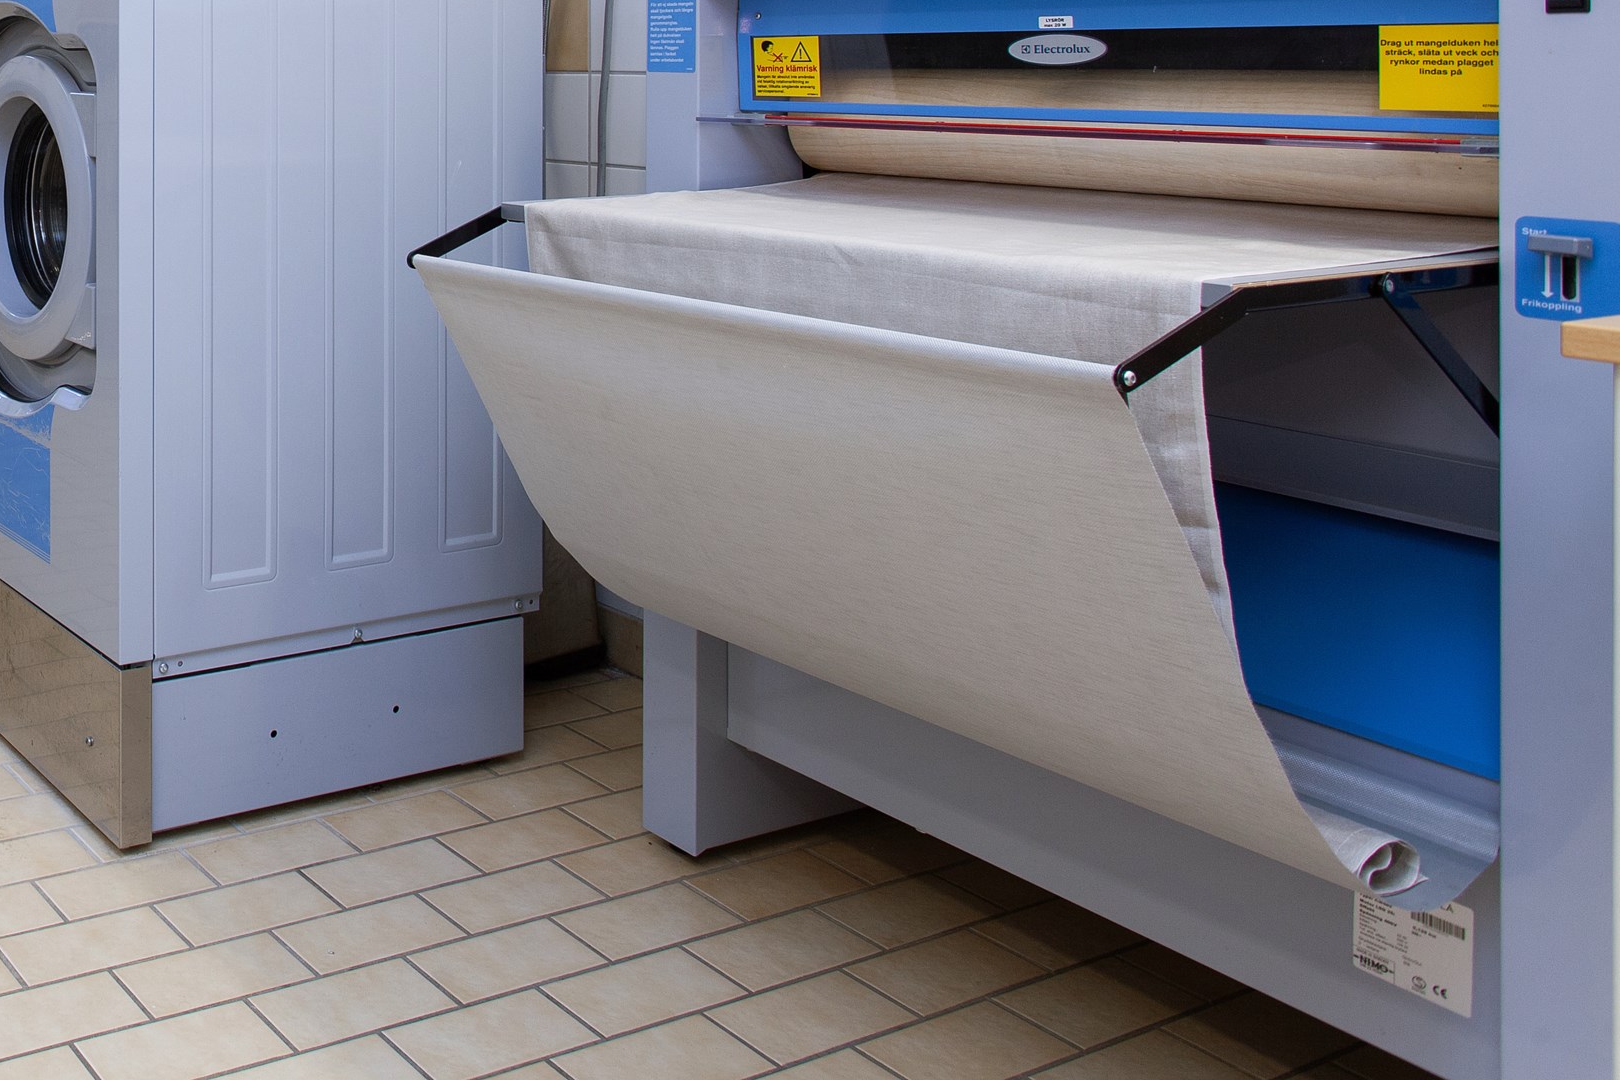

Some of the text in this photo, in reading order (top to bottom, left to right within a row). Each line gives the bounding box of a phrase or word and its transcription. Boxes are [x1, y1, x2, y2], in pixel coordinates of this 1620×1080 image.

[1380, 39, 1402, 48] Drag
[1416, 39, 1481, 48] mangelduken
[1034, 44, 1090, 54] Electrolux
[1385, 49, 1415, 57] sträck,
[1390, 58, 1494, 68] rynkor medan plagget
[757, 65, 784, 73] Varning
[1450, 68, 1463, 77] på
[1521, 227, 1547, 235] Start
[1521, 298, 1582, 314] Frikoppling
[1359, 954, 1389, 974] NIMO
